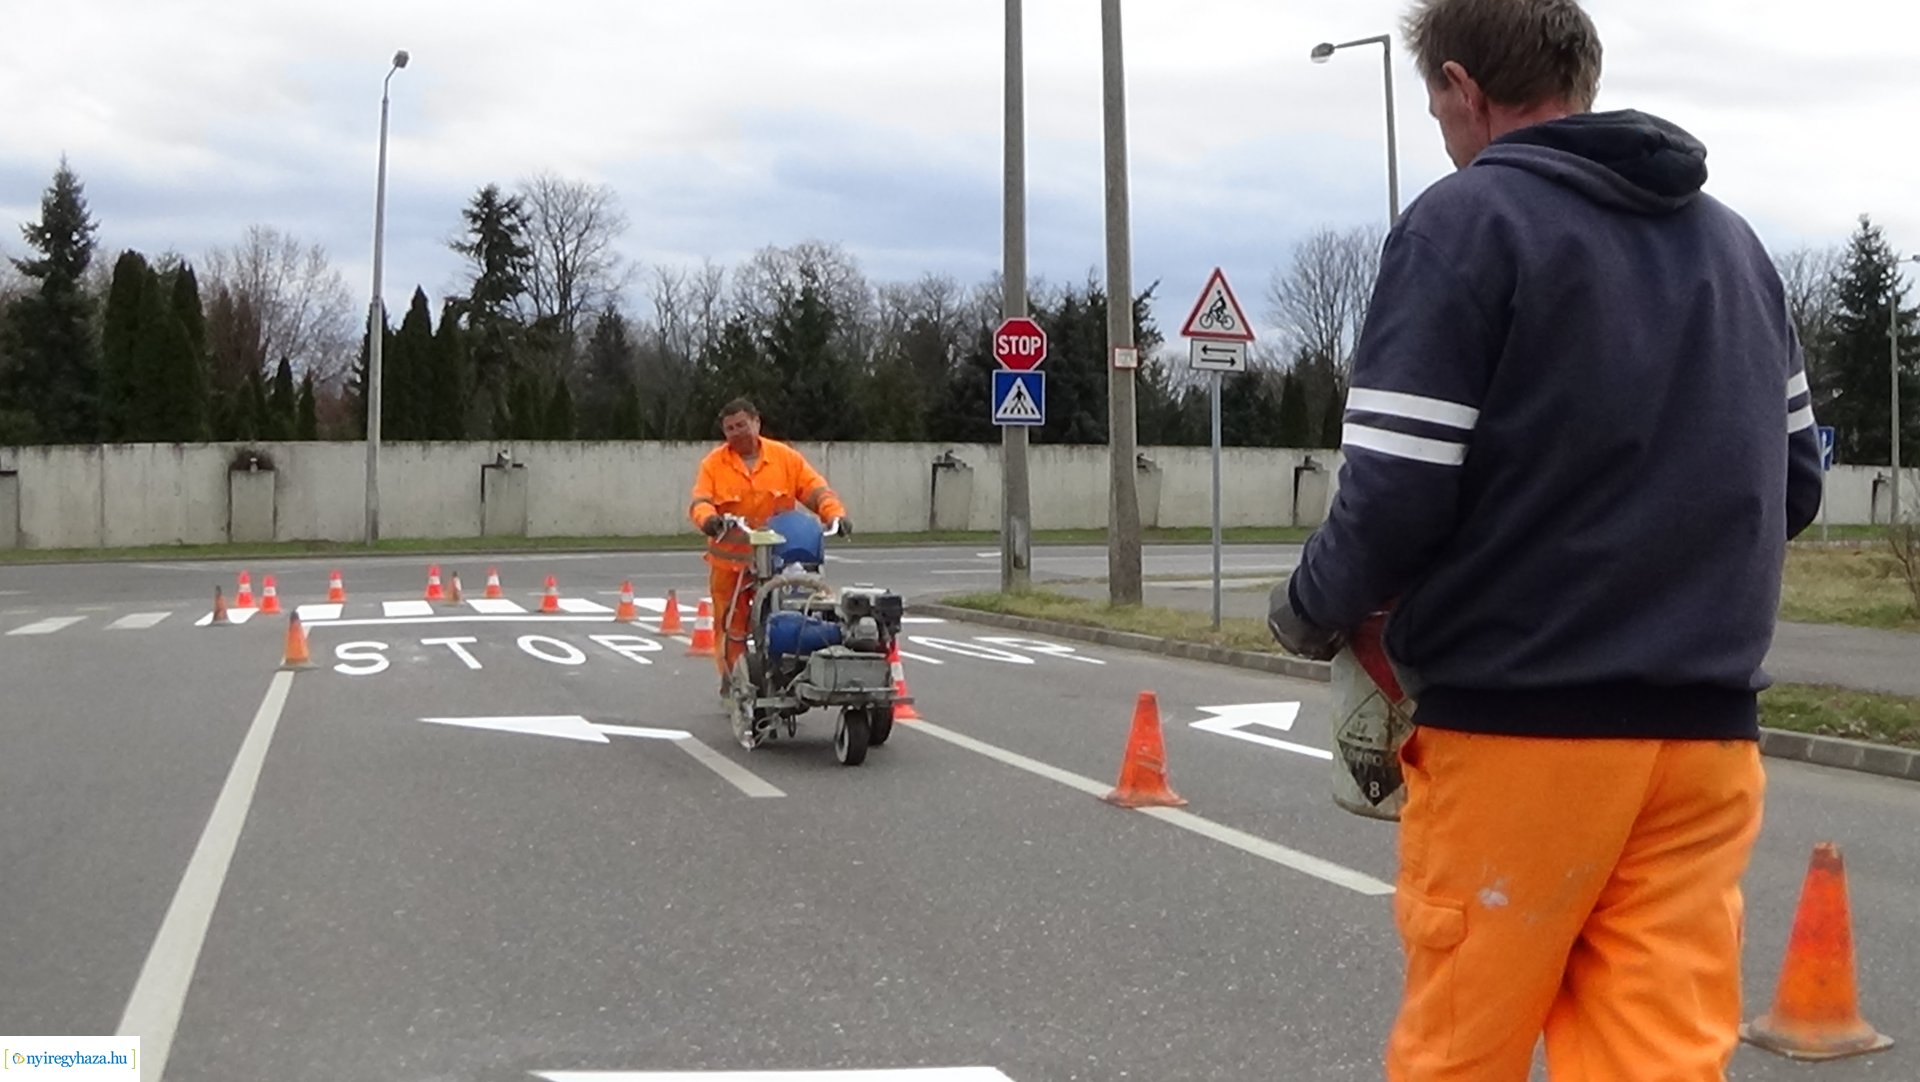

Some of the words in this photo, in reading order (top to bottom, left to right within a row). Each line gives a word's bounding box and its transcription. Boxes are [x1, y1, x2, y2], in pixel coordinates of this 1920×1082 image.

[997, 335, 1042, 356] STOP
[333, 633, 663, 676] STOP
[1369, 780, 1381, 798] 8
